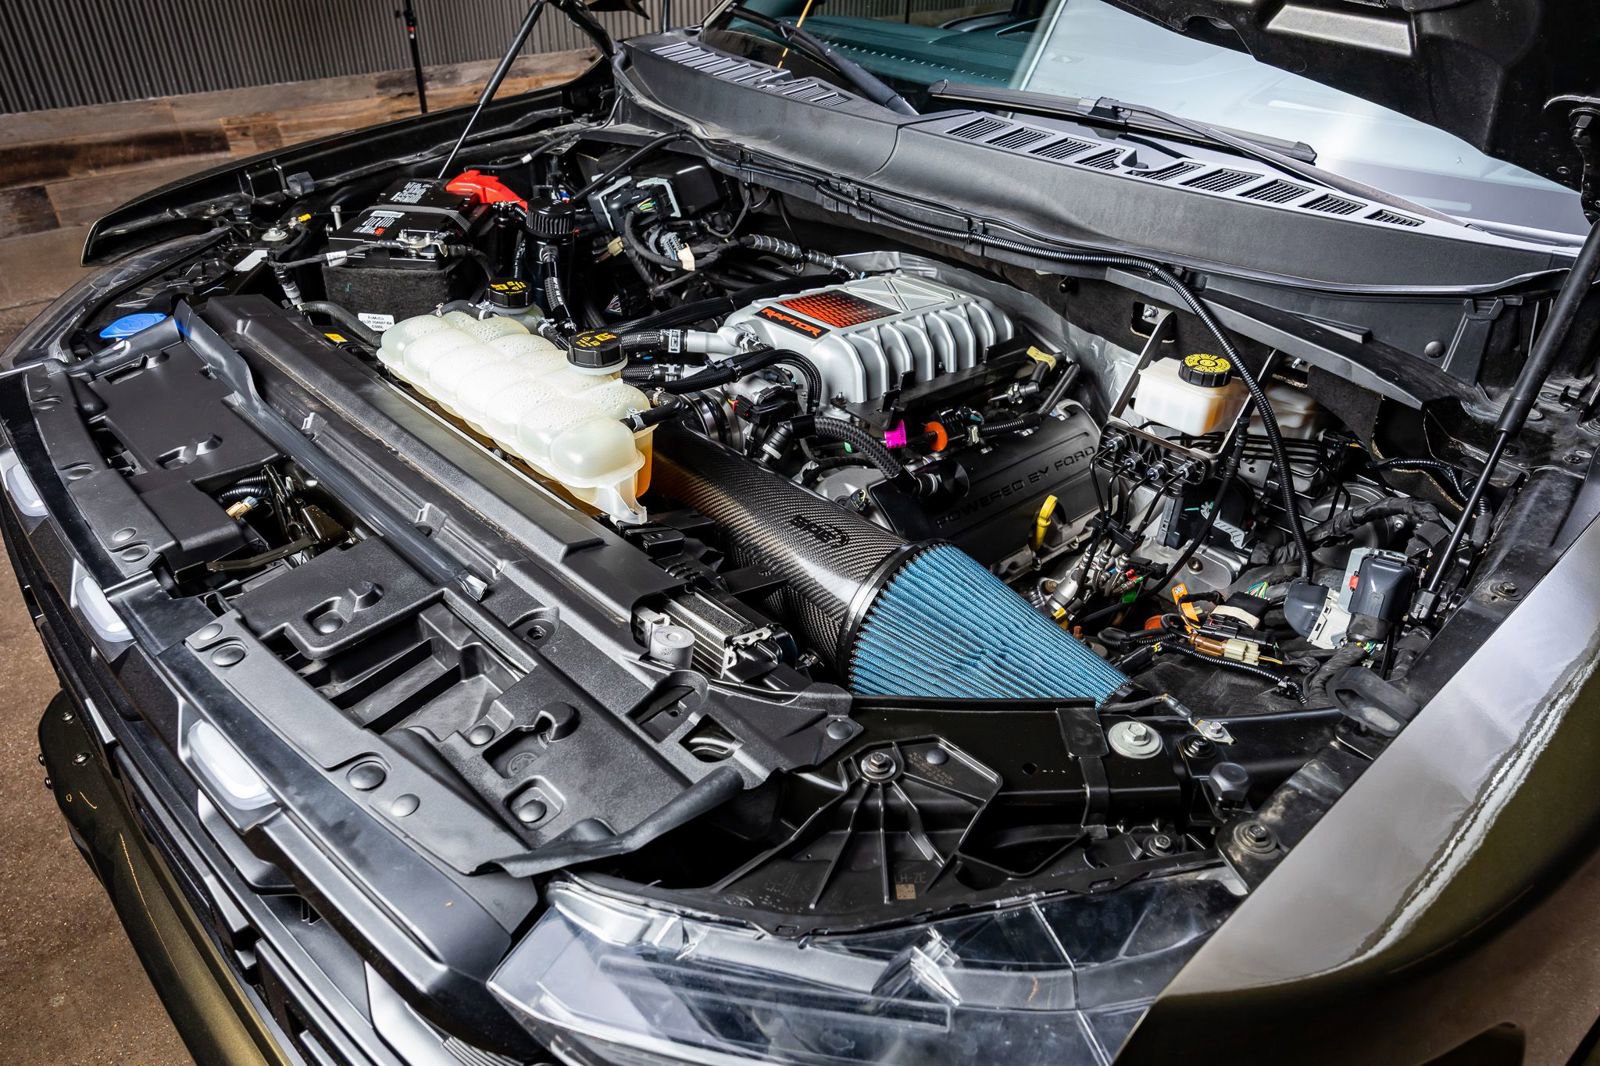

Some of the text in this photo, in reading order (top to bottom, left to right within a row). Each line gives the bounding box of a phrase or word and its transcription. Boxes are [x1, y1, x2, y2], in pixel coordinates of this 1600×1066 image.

[761, 307, 822, 337] RAPTOR
[936, 446, 1096, 529] POWERED BY FORD
